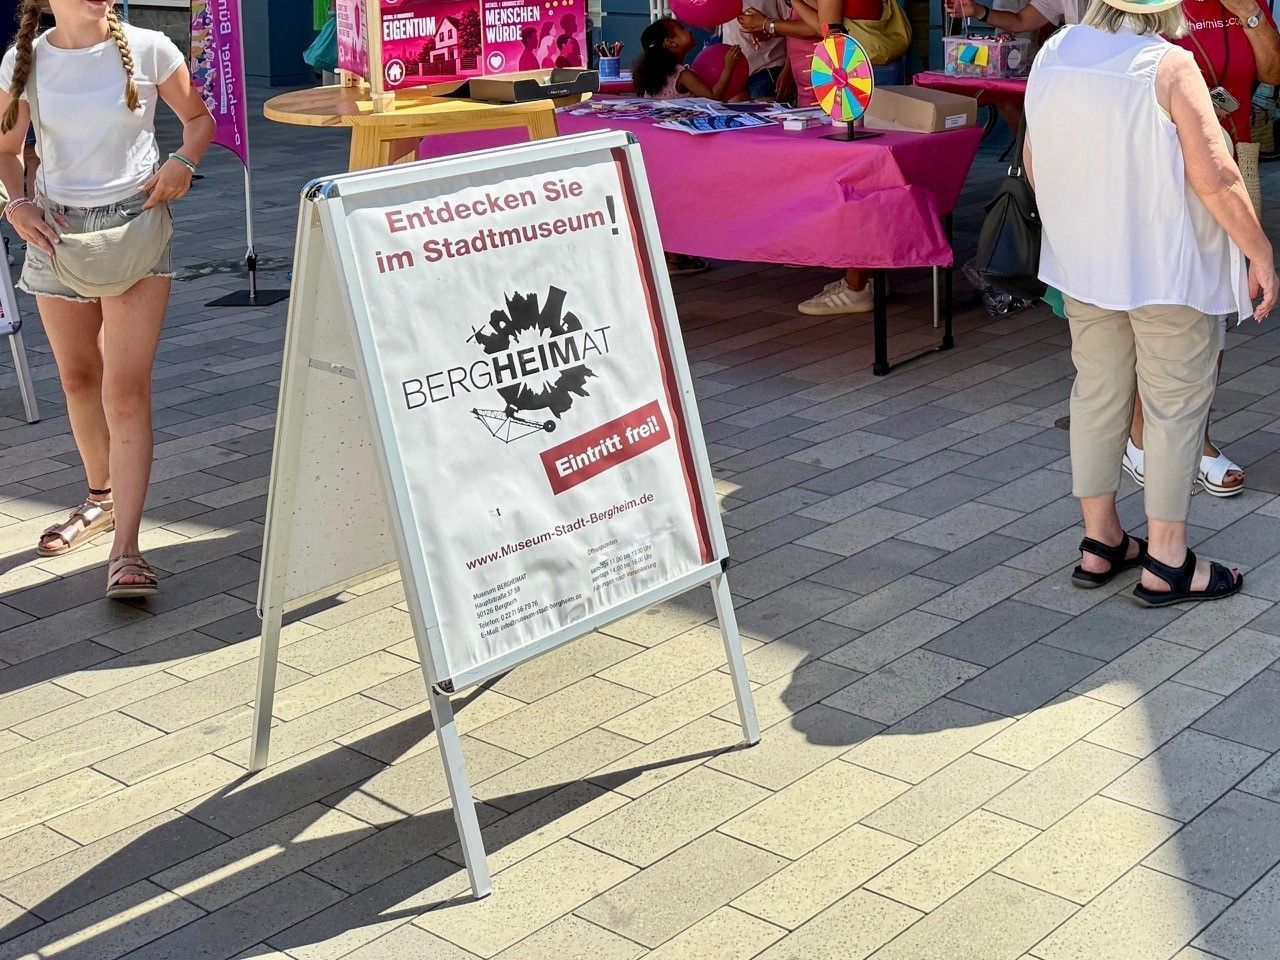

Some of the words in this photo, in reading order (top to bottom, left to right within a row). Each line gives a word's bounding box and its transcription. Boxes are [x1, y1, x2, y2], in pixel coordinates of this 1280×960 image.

[383, 16, 436, 41] EIGENTUM
[485, 5, 540, 25] MENSCHEN
[486, 23, 523, 43] WÜRDE
[385, 193, 537, 234] Entdecken
[542, 178, 584, 202] Sie
[375, 250, 415, 274] im
[402, 325, 611, 410] BERGHEIMAT
[554, 435, 623, 478] Eintritt
[624, 415, 661, 445] frei!
[465, 492, 654, 571] www.Museum-Stadt-Bergheim.de
